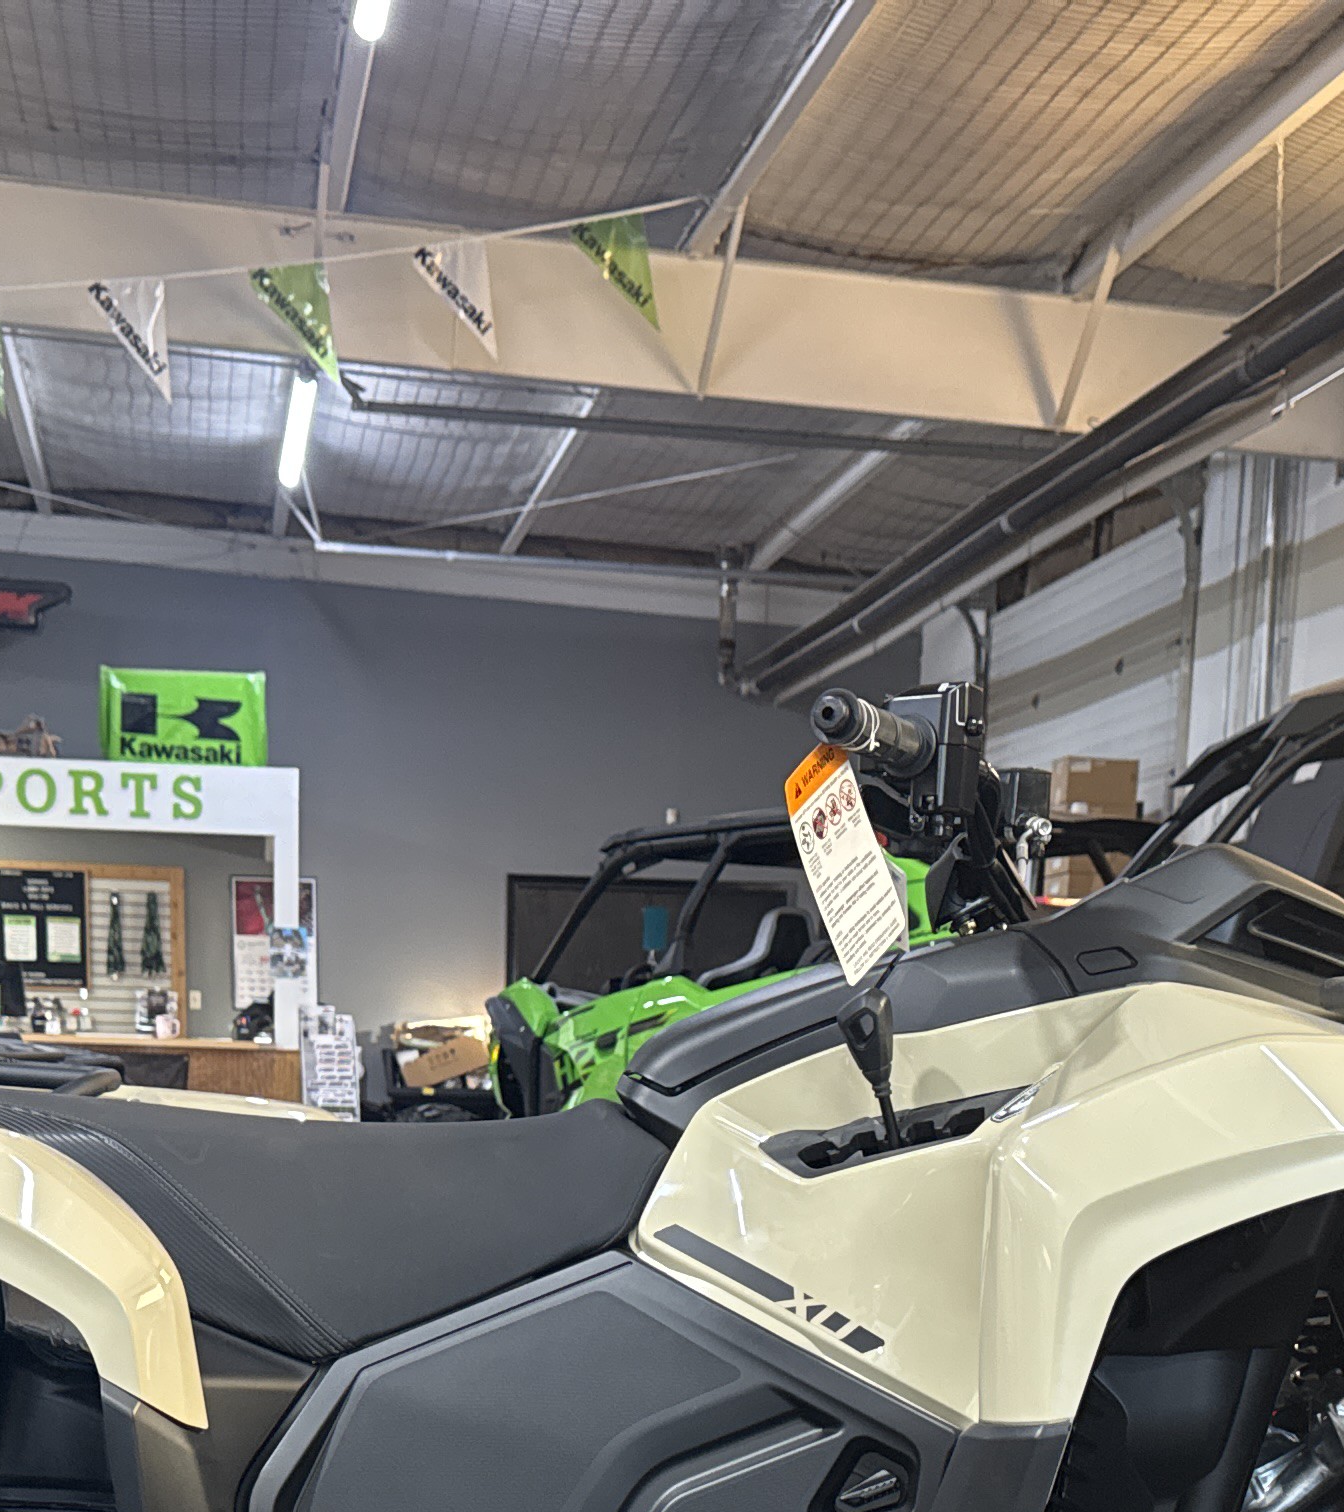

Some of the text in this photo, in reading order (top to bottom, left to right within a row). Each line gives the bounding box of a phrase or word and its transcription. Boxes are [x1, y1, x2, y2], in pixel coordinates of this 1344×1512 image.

[414, 246, 493, 337] Kawasaki
[570, 222, 654, 309] Kawasaki
[88, 282, 166, 377] Kawasaki
[251, 267, 330, 360] Kawasaki
[119, 734, 243, 766] Kawasaki
[801, 747, 836, 788] WARNING
